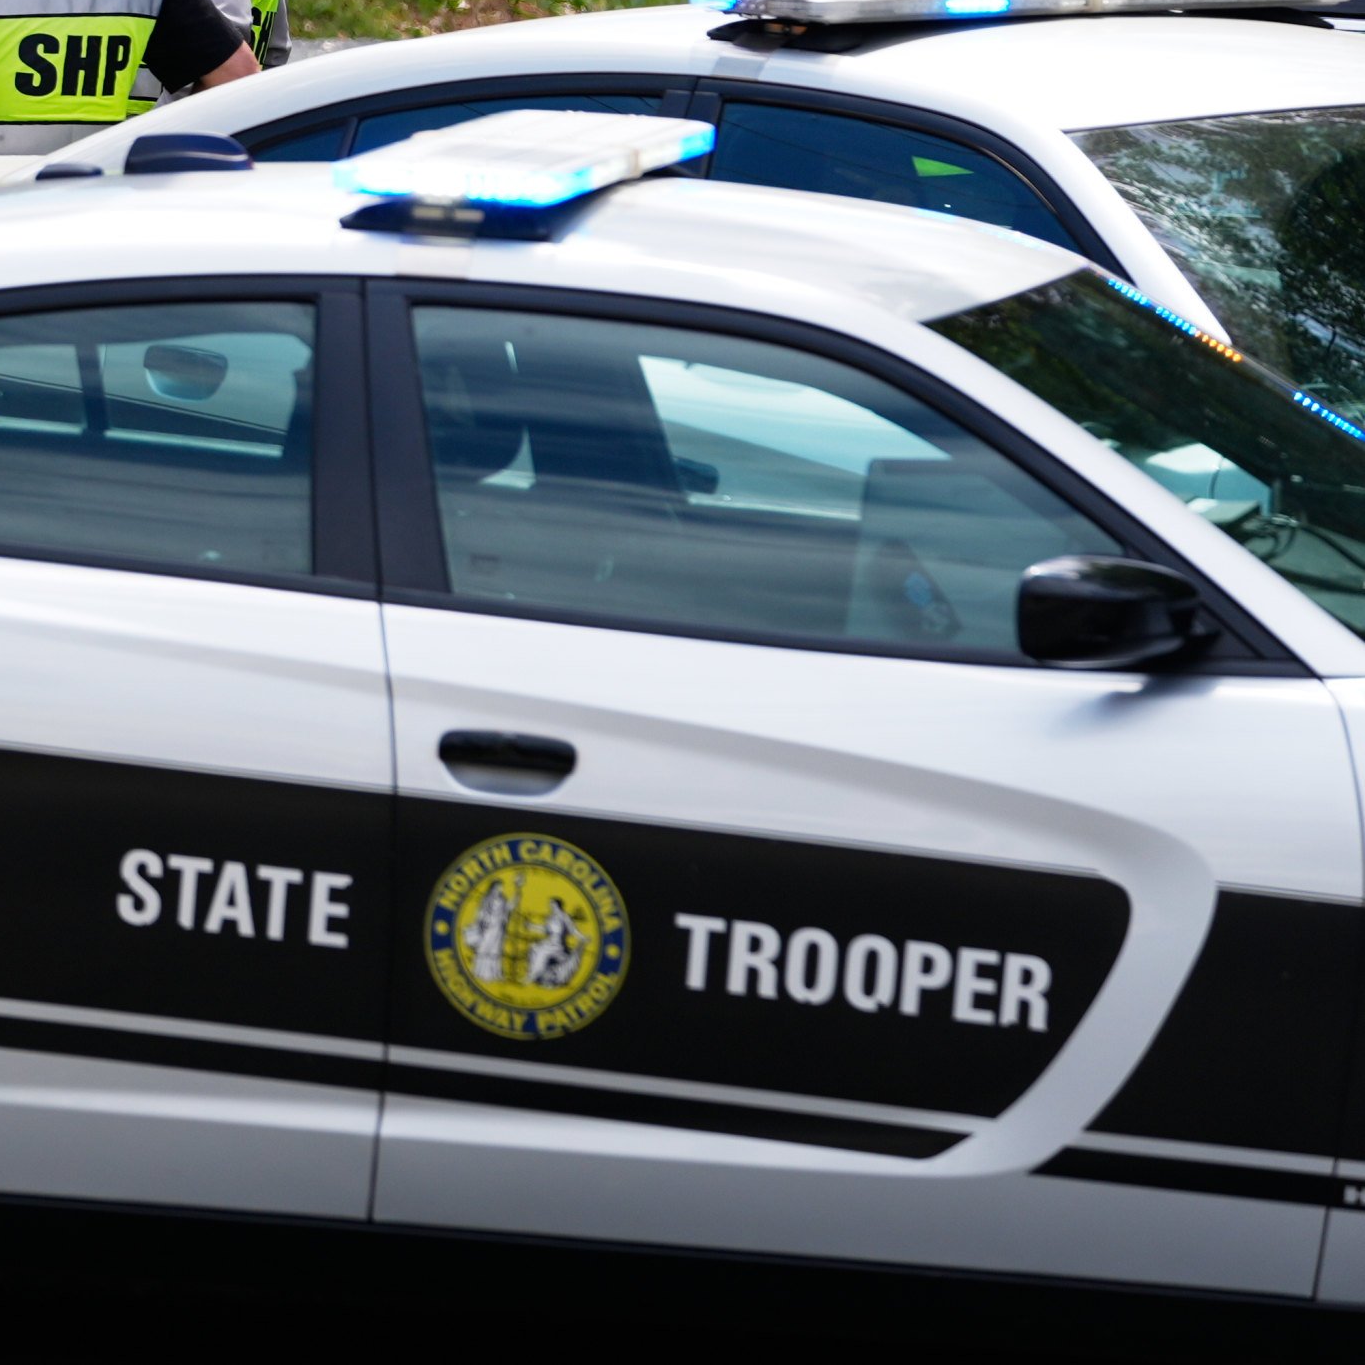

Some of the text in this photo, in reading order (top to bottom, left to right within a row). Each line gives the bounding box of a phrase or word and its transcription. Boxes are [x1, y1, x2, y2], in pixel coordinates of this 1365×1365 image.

[14, 33, 132, 96] SHP
[437, 840, 622, 934] NORTH CAROLINA
[116, 848, 1052, 1032] STATE TROOPER
[435, 948, 619, 1033] HIGHWAY PATROL
